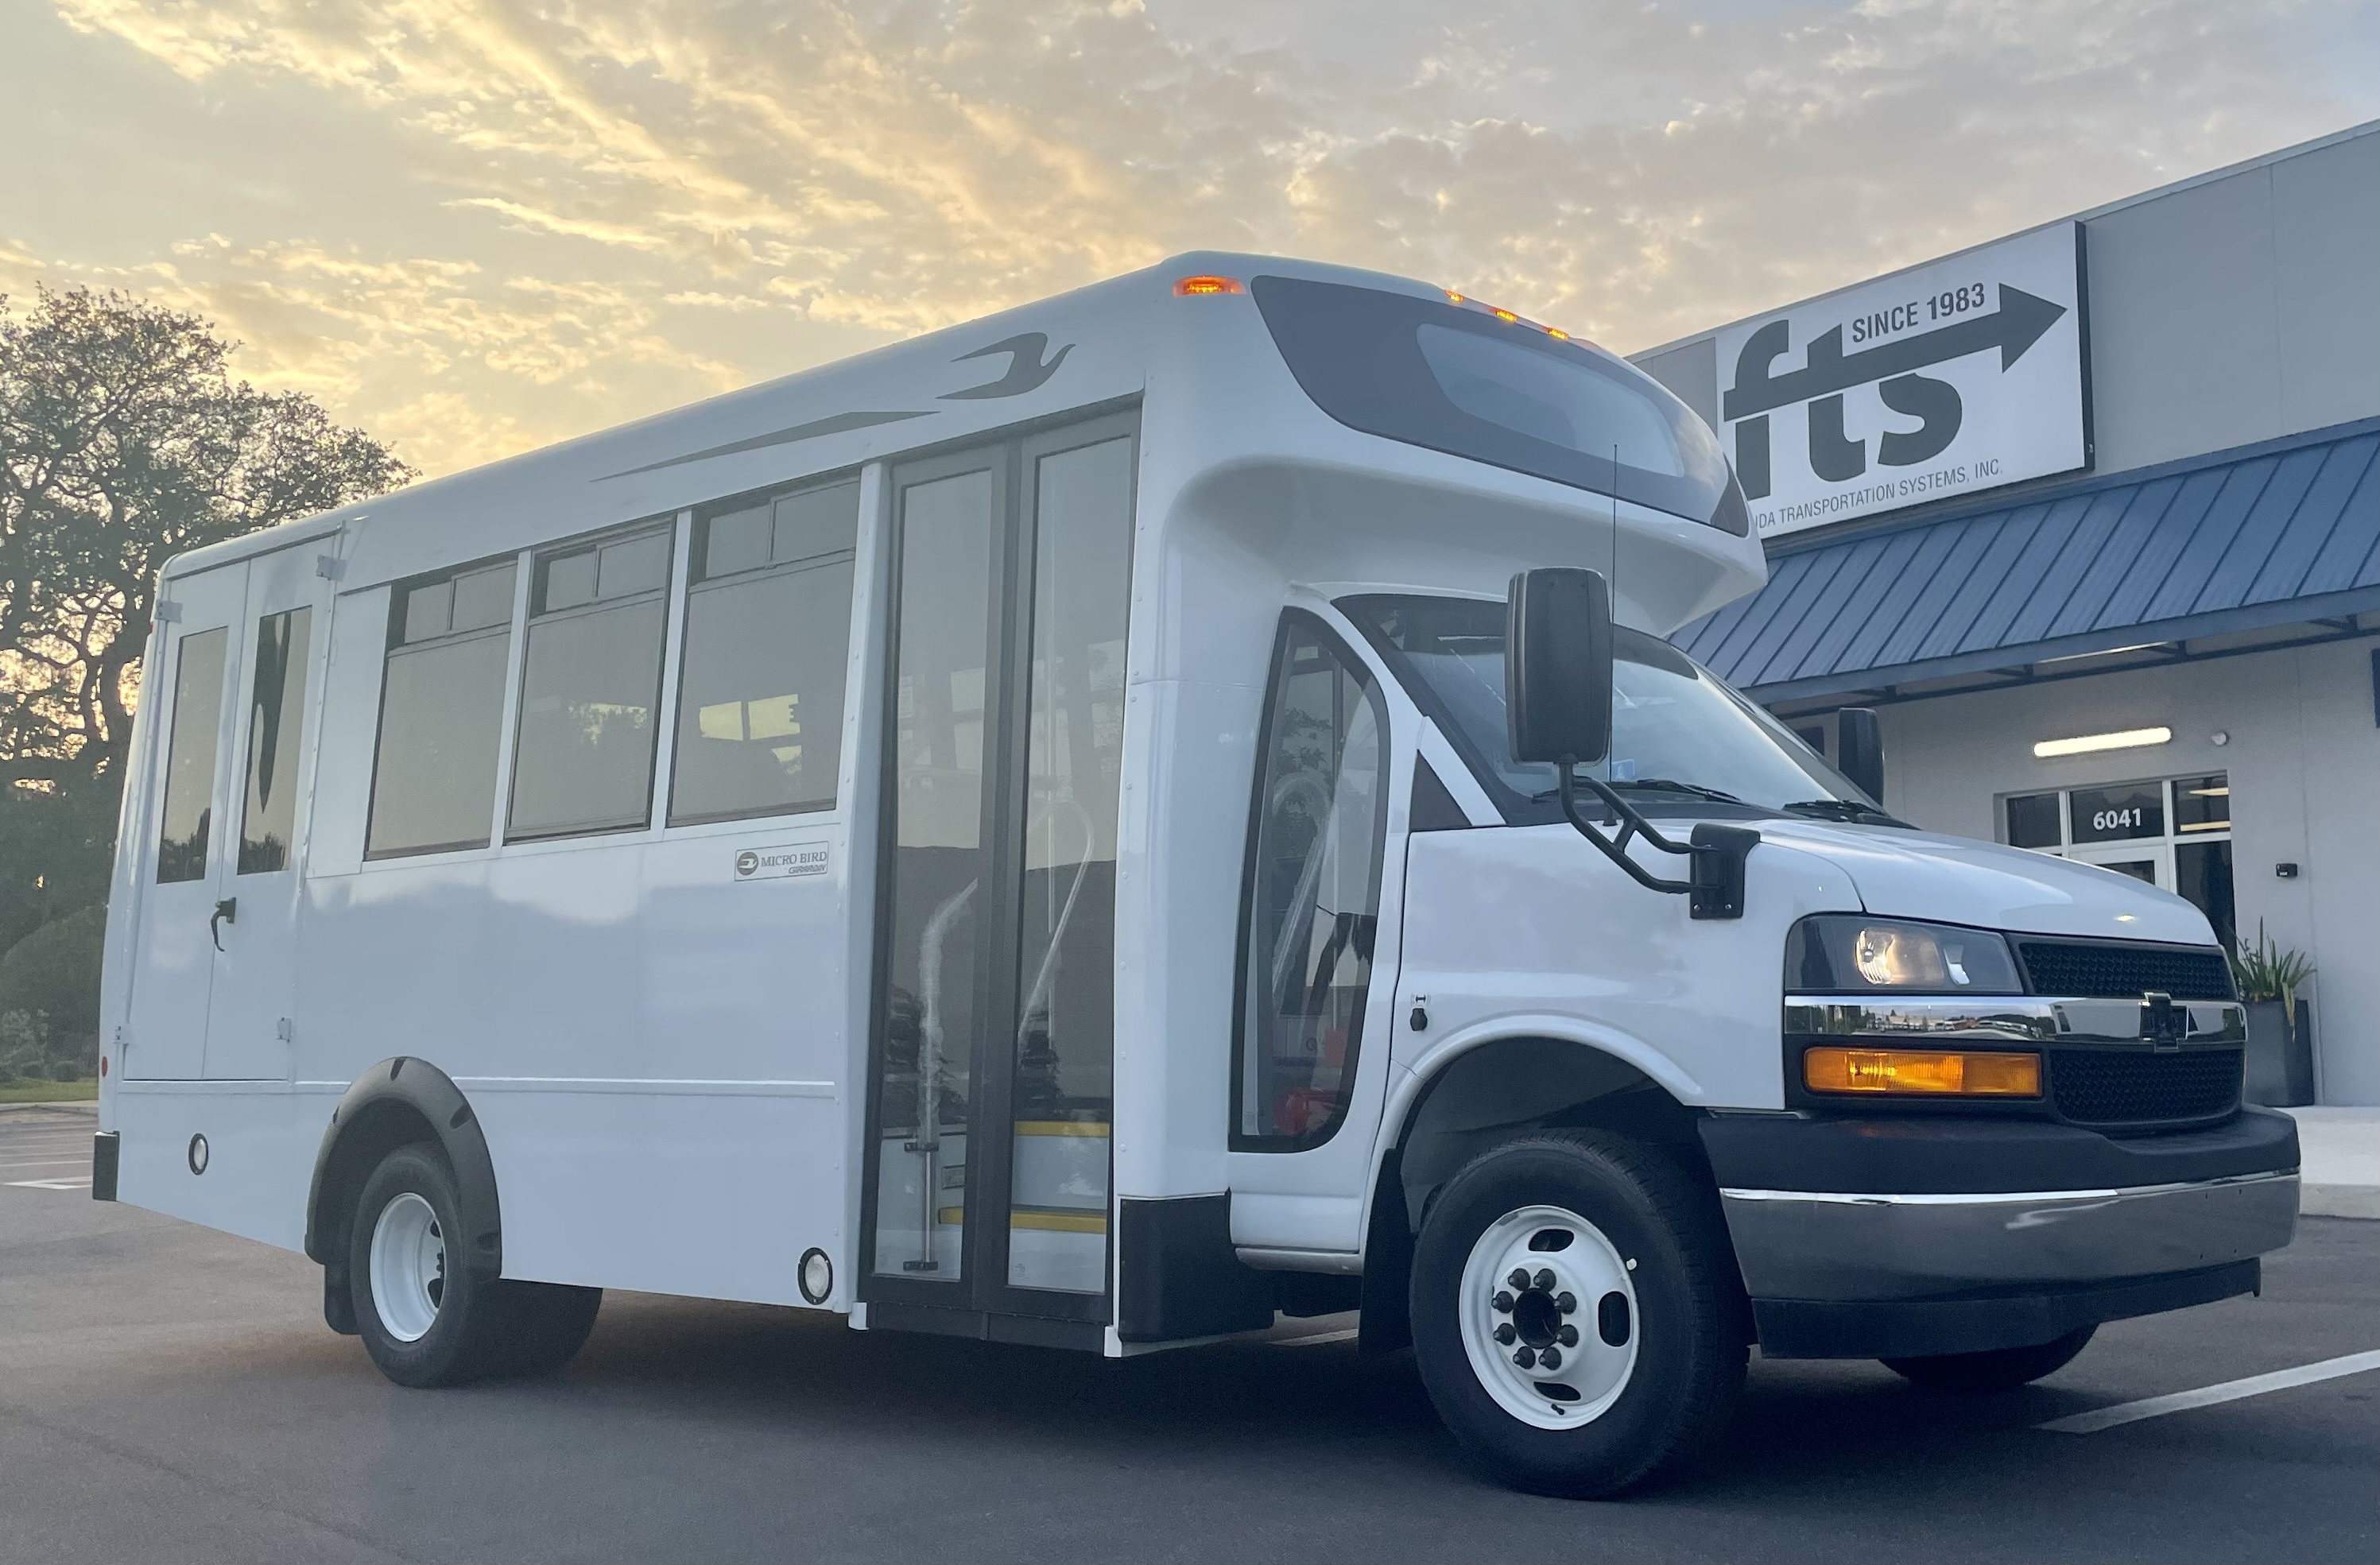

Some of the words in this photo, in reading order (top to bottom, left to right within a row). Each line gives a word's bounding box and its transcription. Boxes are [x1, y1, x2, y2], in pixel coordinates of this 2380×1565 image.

[1852, 301, 1918, 343] SINCE
[1926, 282, 1985, 320] 1983
[1723, 319, 1963, 502] fts
[1754, 511, 1776, 529] IDA
[1779, 482, 1895, 525] TRANSPORTATION
[1899, 466, 1970, 496] SYSTEMS,
[1975, 458, 2003, 479] INC.
[2092, 807, 2142, 831] 6041
[762, 854, 797, 866] MICRO
[800, 851, 827, 862] BIRD
